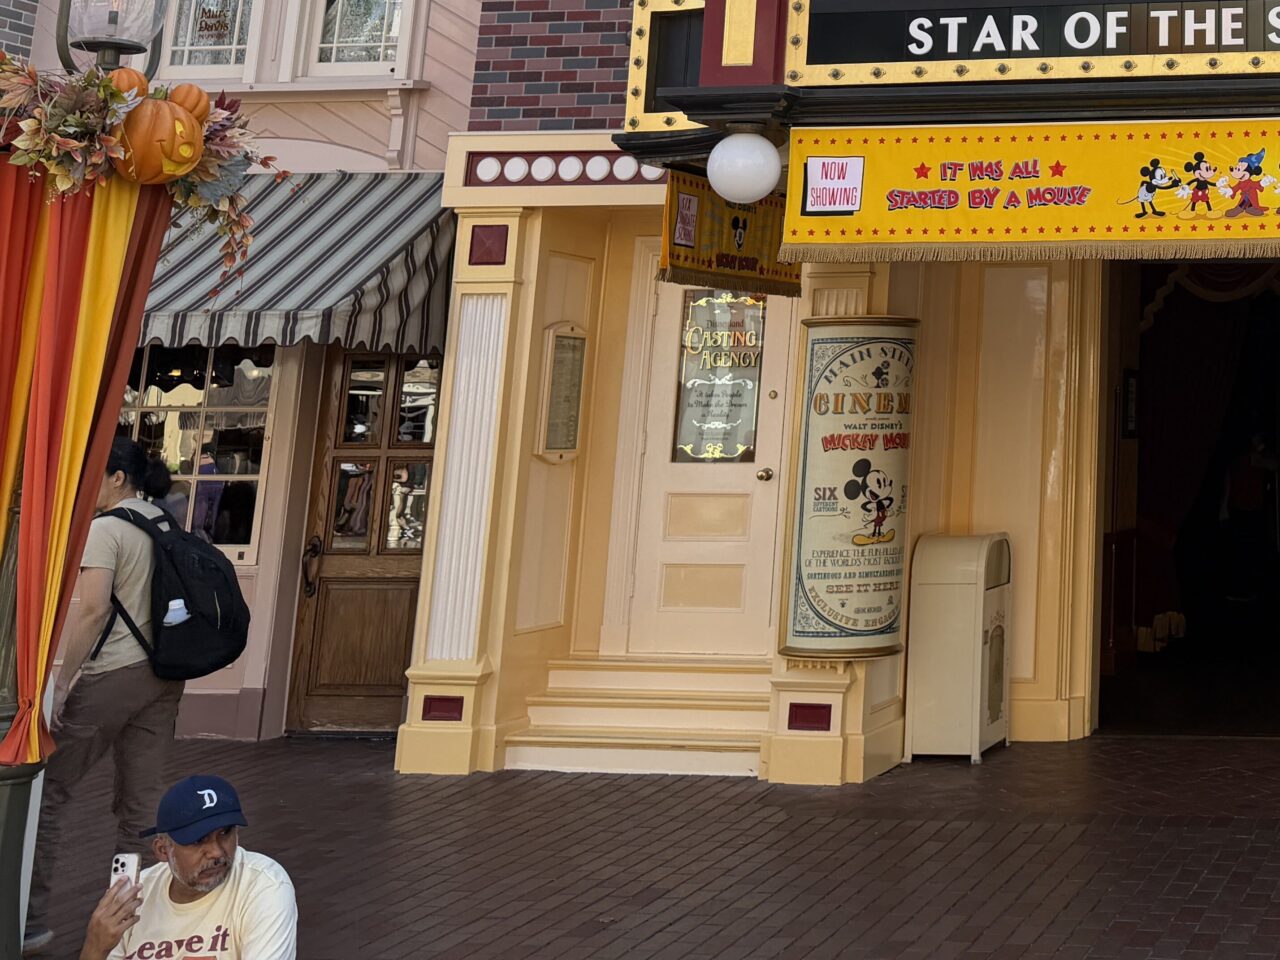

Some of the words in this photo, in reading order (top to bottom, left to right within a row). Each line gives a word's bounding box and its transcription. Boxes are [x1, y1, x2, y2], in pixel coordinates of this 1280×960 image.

[906, 14, 1041, 56] STAR
[1063, 11, 1130, 50] OF
[1149, 7, 1246, 47] THE
[820, 161, 848, 181] NOW
[940, 161, 965, 181] IT
[968, 159, 1003, 181] WAS
[1008, 159, 1041, 179] ALL
[810, 187, 858, 207] SHOWING
[886, 189, 961, 211] STARTED
[967, 187, 1001, 210] BY
[1003, 189, 1022, 211] A
[1026, 184, 1092, 208] MOUSE
[685, 327, 757, 355] CASTING
[700, 350, 760, 370] AGENCY
[823, 347, 873, 384] MAIN
[813, 392, 912, 416] CINEM
[871, 421, 903, 430] DISNEY'S
[821, 433, 879, 452] MICKEY
[814, 486, 838, 501] SIX
[853, 548, 867, 557] THE
[815, 559, 828, 567] THE
[826, 584, 853, 593] SEE
[856, 583, 871, 593] IT
[808, 586, 859, 627] EXCLUSIVE
[197, 789, 218, 809] D
[207, 925, 230, 952] it
